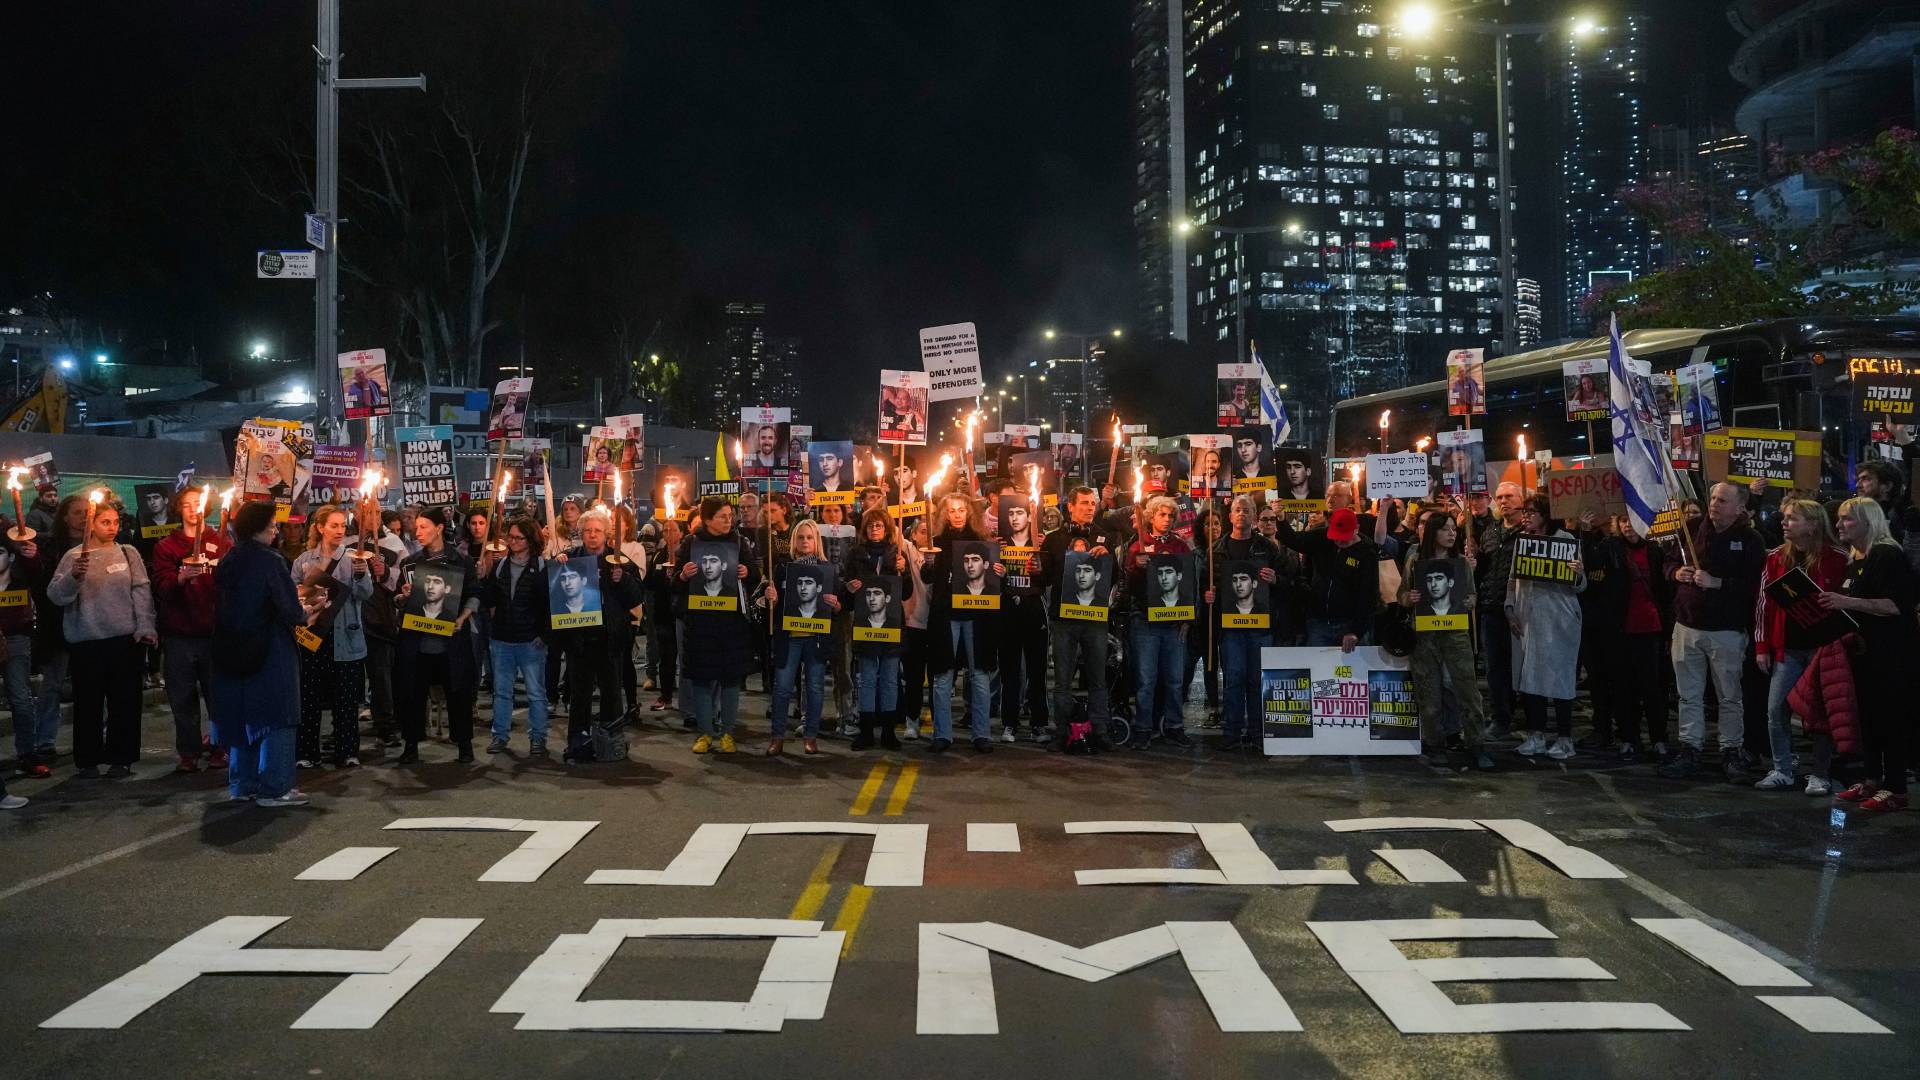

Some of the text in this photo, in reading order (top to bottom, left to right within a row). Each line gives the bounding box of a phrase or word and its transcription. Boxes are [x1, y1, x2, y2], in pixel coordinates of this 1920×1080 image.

[929, 365, 977, 378] ONLY MORE
[931, 378, 978, 390] DEFENDERS
[1867, 386, 1912, 400] עסקה
[1863, 400, 1915, 414] עכשיו!
[407, 440, 443, 453] HOW
[1735, 438, 1792, 451] די למלחמה
[404, 452, 447, 465] MUCH
[1408, 455, 1425, 463] אלה
[1745, 460, 1771, 469] STOP
[405, 464, 450, 478] BLOOD
[1381, 467, 1426, 477] מחכים לנו
[1745, 468, 1791, 479] THE WAR
[403, 479, 453, 493] WILL BE
[701, 481, 739, 495] אתם בבית
[1371, 480, 1427, 490] בשארית כוחם
[405, 491, 455, 506] SPILLED?
[1518, 538, 1576, 560] אתם בבית
[1516, 556, 1553, 579] בעזה!
[1557, 561, 1575, 581] הם
[962, 599, 973, 607] כהן
[1249, 617, 1259, 625] טל
[1432, 618, 1440, 626] לוי
[1334, 665, 1353, 679] 465
[1273, 690, 1287, 701] הם
[1339, 681, 1368, 698] כולם
[1313, 699, 1369, 716] הומניטרי
[294, 817, 1627, 886] הביתה
[38, 916, 1894, 1036] HOME!
